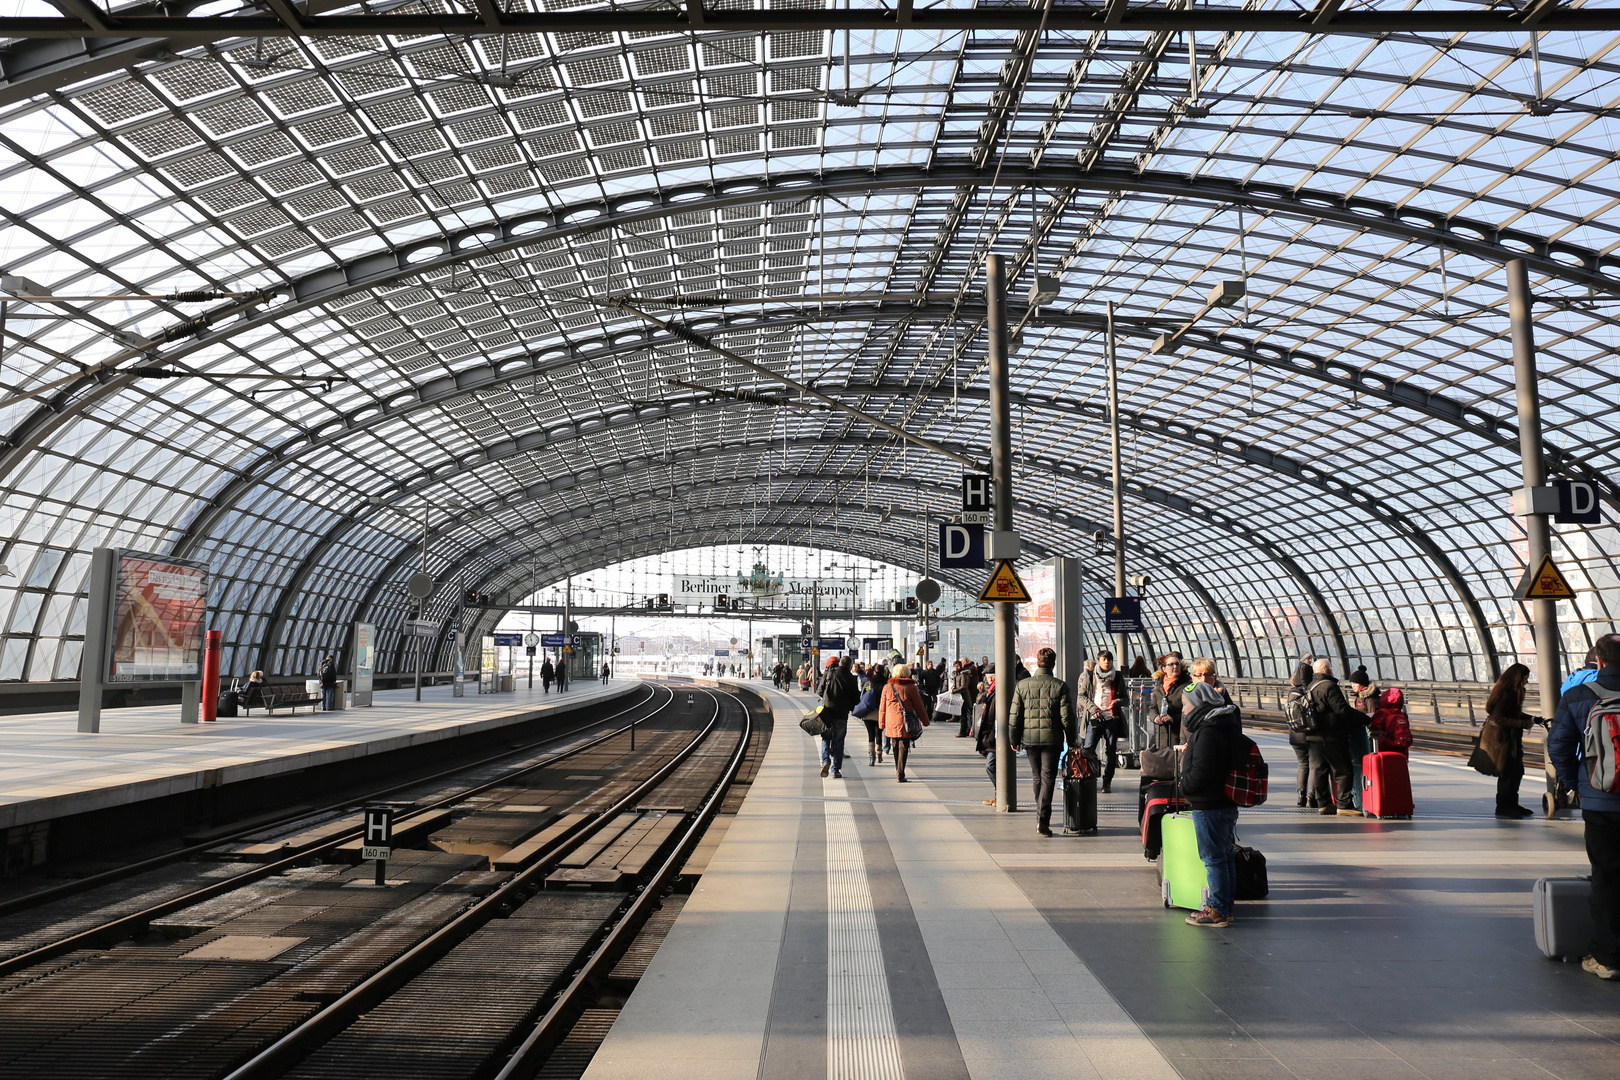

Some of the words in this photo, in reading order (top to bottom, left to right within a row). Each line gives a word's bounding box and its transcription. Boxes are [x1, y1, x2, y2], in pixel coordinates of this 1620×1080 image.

[967, 479, 985, 506] H
[1570, 482, 1595, 514] D
[964, 513, 977, 522] 160
[945, 526, 971, 559] D
[681, 579, 731, 593] Berliner
[789, 582, 860, 598] Morgenpost
[368, 813, 387, 841] H
[365, 849, 377, 857] 160
